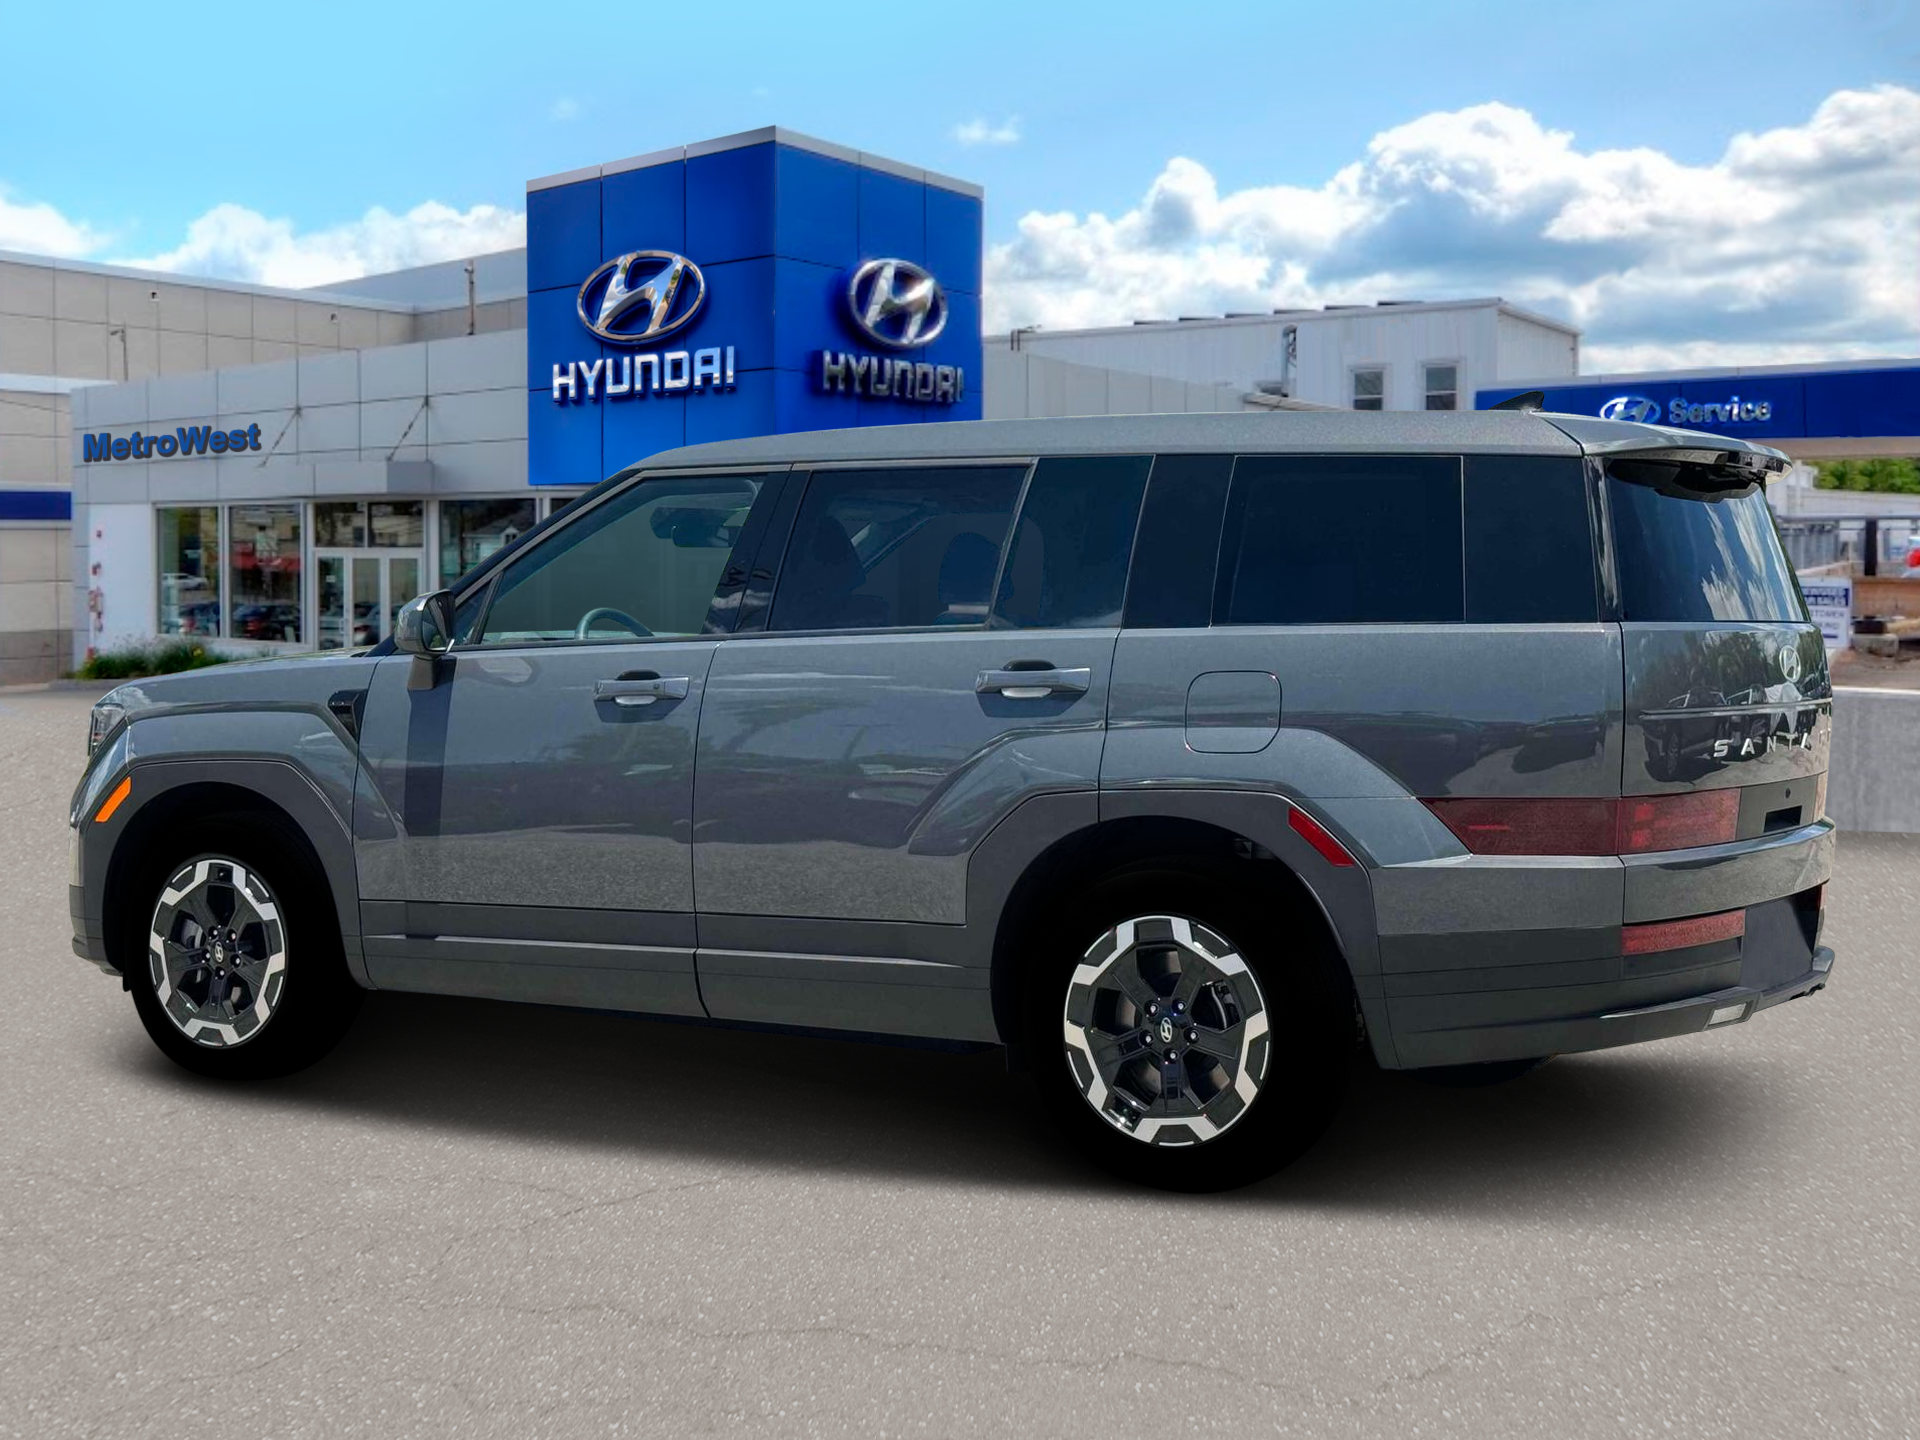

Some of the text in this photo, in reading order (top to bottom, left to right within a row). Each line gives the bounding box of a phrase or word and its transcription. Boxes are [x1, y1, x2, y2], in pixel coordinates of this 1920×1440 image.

[552, 345, 735, 401] HYUNDAI
[822, 349, 964, 403] HYUNDAI
[1669, 396, 1771, 423] Service
[83, 423, 261, 462] MetroWest
